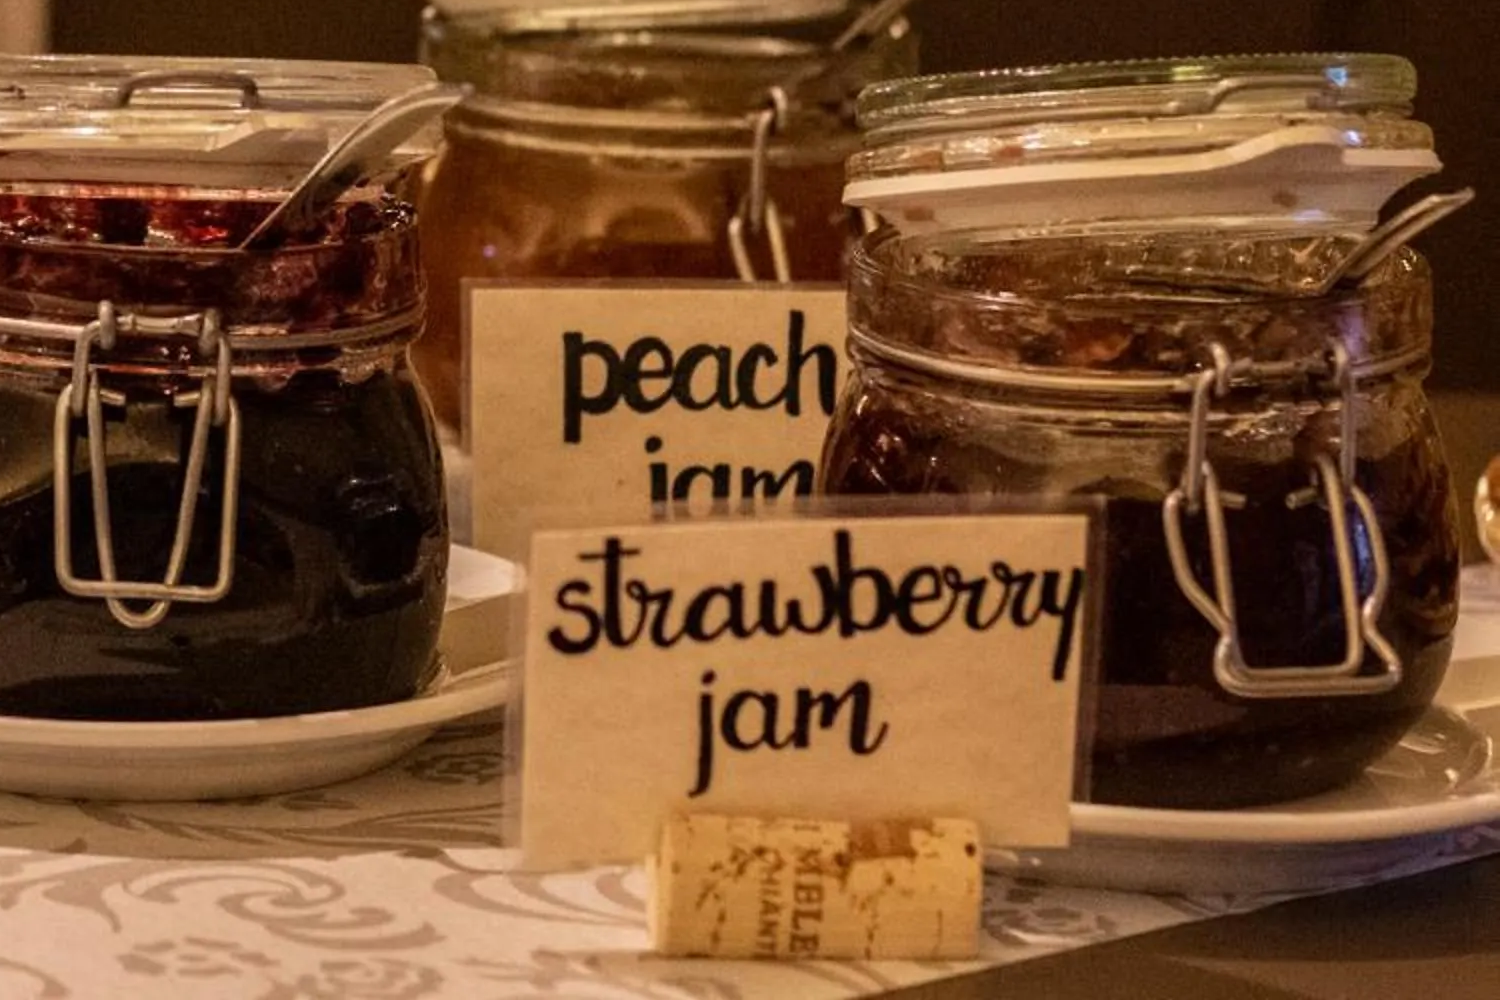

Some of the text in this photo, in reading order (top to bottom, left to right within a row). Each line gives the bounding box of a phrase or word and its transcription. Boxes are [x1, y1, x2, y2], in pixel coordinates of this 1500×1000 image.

[563, 310, 838, 443] peach
[547, 530, 1084, 681] strawberry
[688, 670, 888, 798] jam
